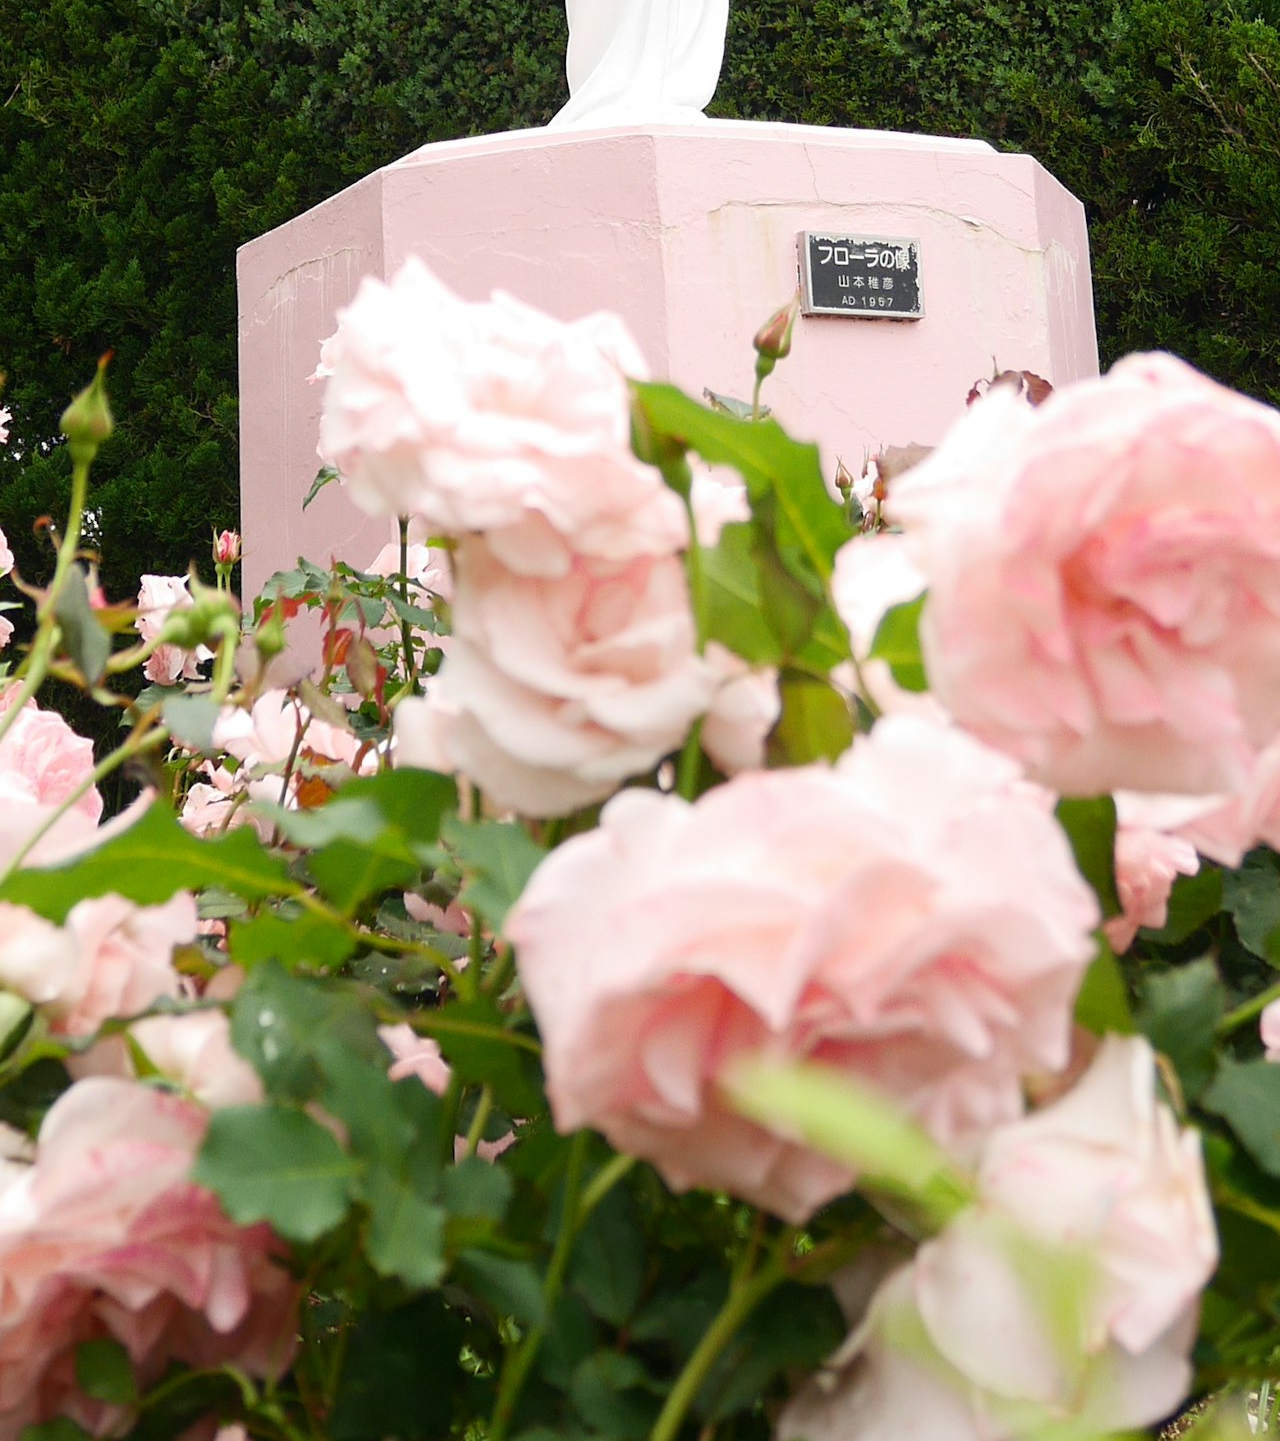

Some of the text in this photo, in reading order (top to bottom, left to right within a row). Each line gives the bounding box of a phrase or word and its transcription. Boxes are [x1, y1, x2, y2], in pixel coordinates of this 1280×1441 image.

[818, 246, 910, 271] フローラの像
[841, 295, 856, 306] AD
